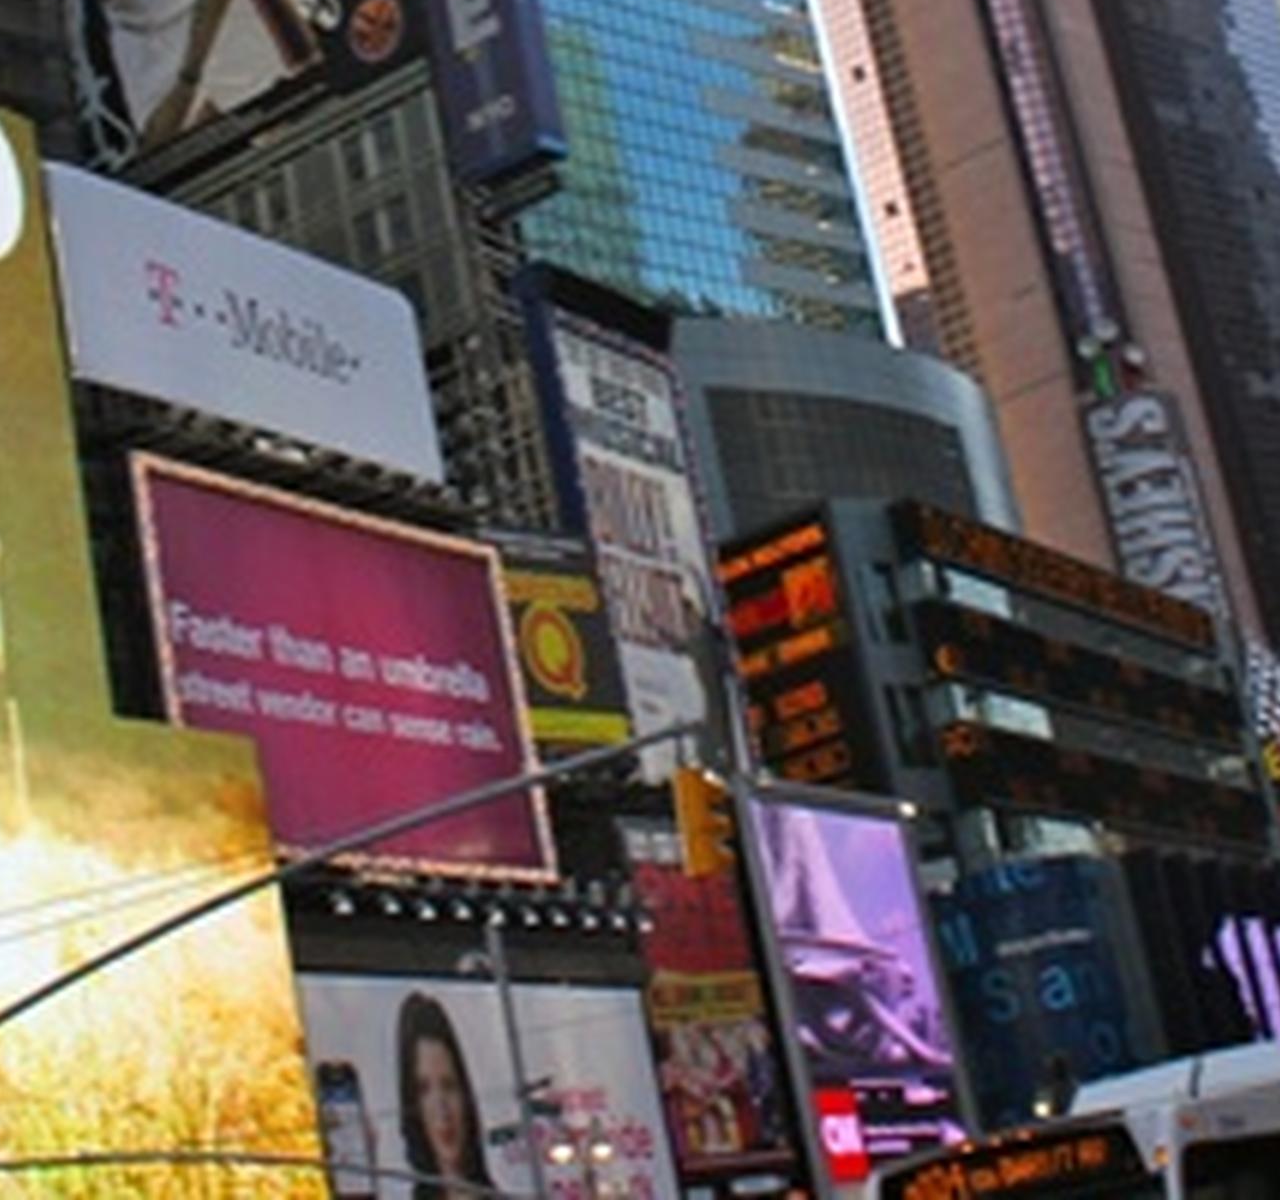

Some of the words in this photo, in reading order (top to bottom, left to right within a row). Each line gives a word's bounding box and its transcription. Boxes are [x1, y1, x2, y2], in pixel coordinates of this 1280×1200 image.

[169, 601, 262, 660] Faster
[269, 623, 334, 673] than
[338, 646, 374, 683] an
[379, 654, 491, 702] umbrella
[178, 671, 253, 713] street
[256, 685, 337, 727] vendor
[343, 702, 385, 734] can
[391, 711, 453, 746] sense
